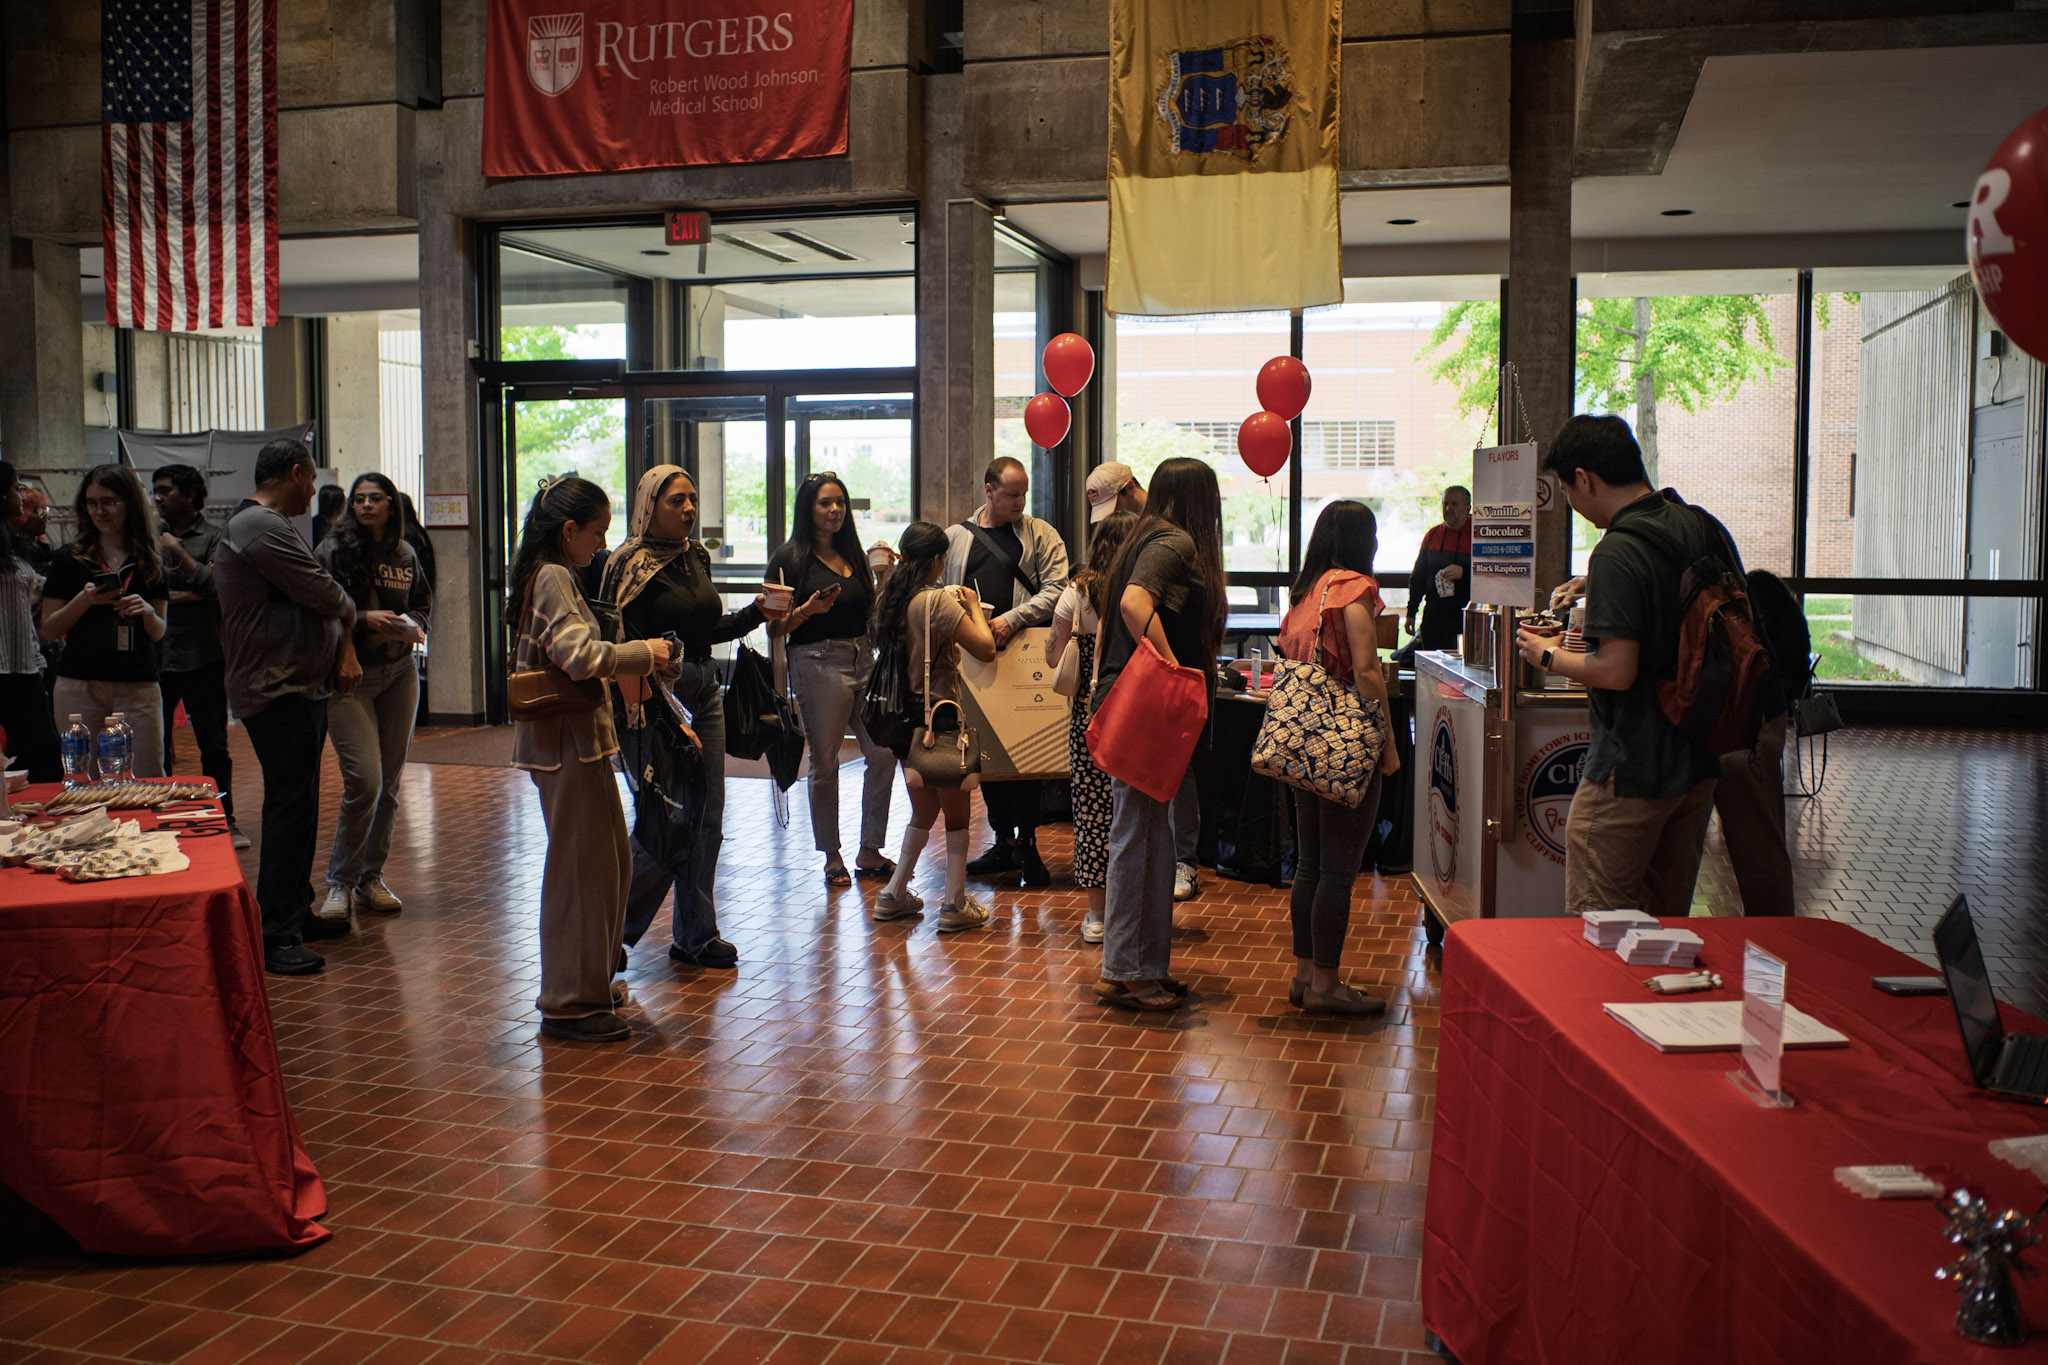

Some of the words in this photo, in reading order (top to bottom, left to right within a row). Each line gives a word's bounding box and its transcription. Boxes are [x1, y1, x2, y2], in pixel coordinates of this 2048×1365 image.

[595, 12, 793, 81] RUTGERS
[649, 76, 698, 95] Robert
[704, 71, 748, 91] Wood
[753, 68, 818, 89] Johnson
[649, 95, 706, 117] Medical
[711, 92, 763, 113] School
[1967, 168, 2015, 258] R
[672, 215, 701, 241] EXIT
[1488, 450, 1519, 463] FLAVORS
[1483, 505, 1520, 518] Vanilla
[1479, 526, 1524, 537] Chocolate
[1476, 564, 1493, 573] Black
[1494, 564, 1527, 576] Raspberry
[1520, 734, 1571, 785] HOMETOWN
